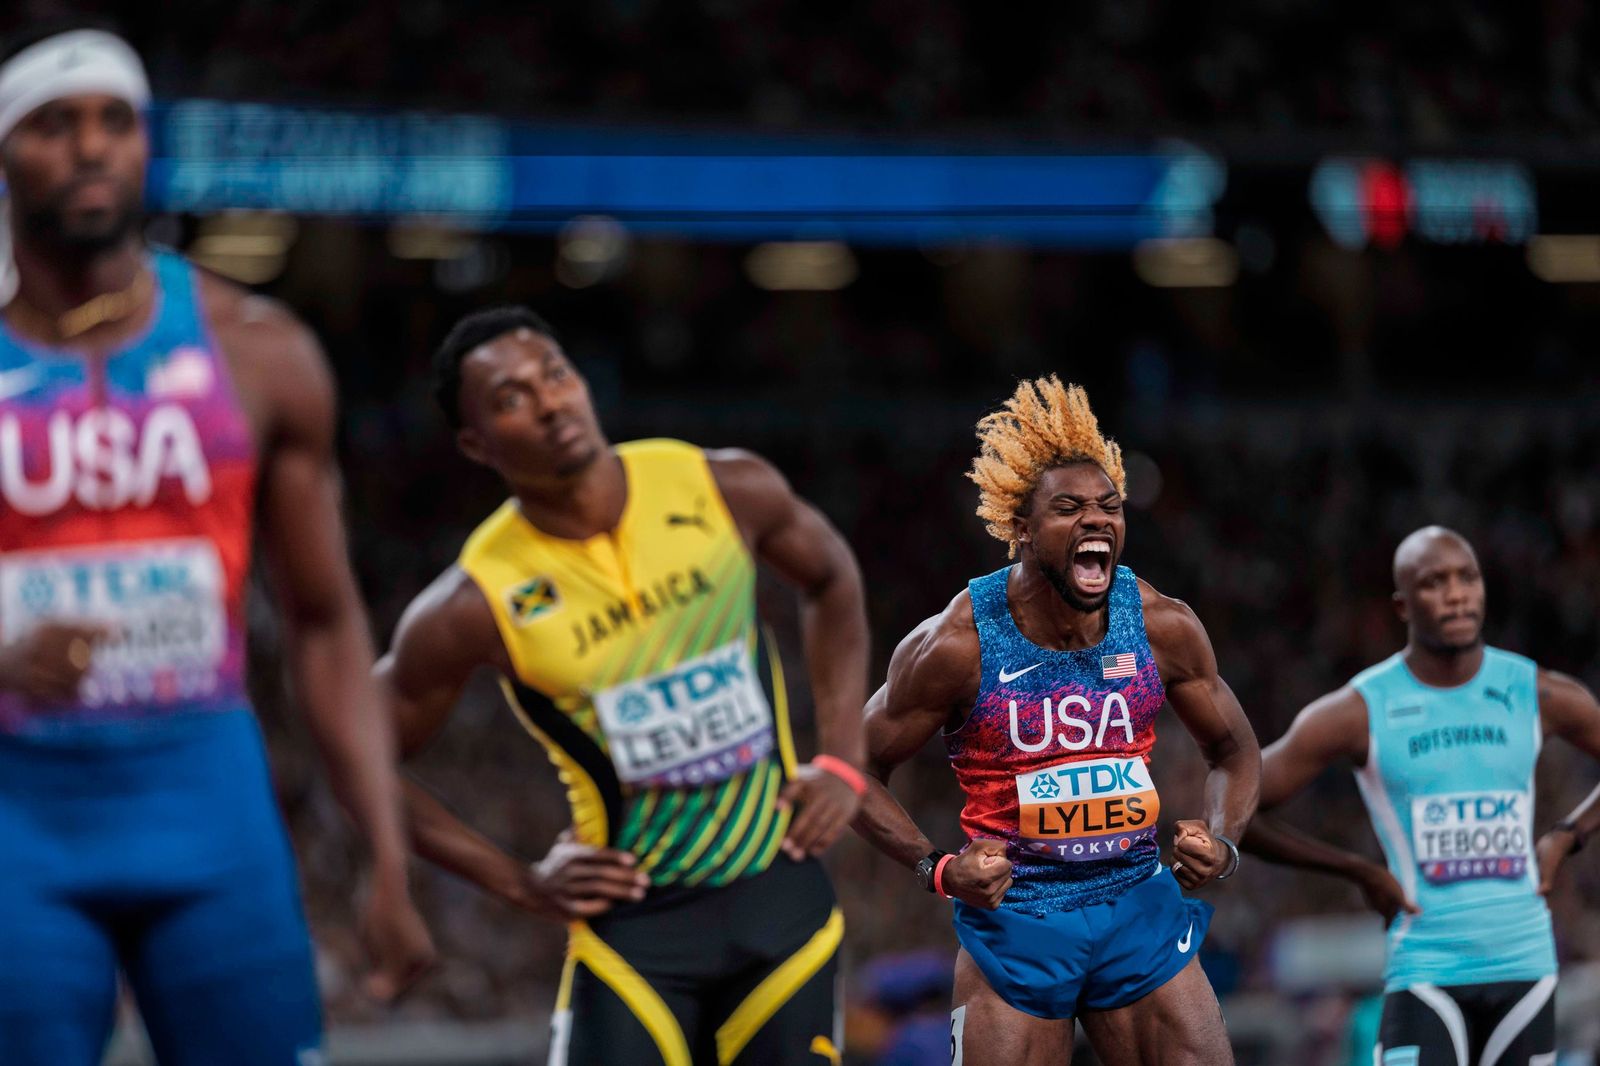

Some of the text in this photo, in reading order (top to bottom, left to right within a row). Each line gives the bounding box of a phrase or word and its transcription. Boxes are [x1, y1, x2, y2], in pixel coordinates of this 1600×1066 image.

[0, 402, 212, 516] USA
[570, 567, 713, 657] JAMAICA
[647, 652, 745, 710] TDK
[620, 697, 757, 769] LEVELL
[1008, 692, 1134, 753] USA
[1408, 726, 1507, 757] BOTSWANA
[1057, 761, 1143, 797] TDK
[1038, 797, 1147, 836] LYLES
[1451, 797, 1520, 821] TDK
[1058, 838, 1131, 856] TOKYO
[1421, 826, 1526, 857] TEBOGO
